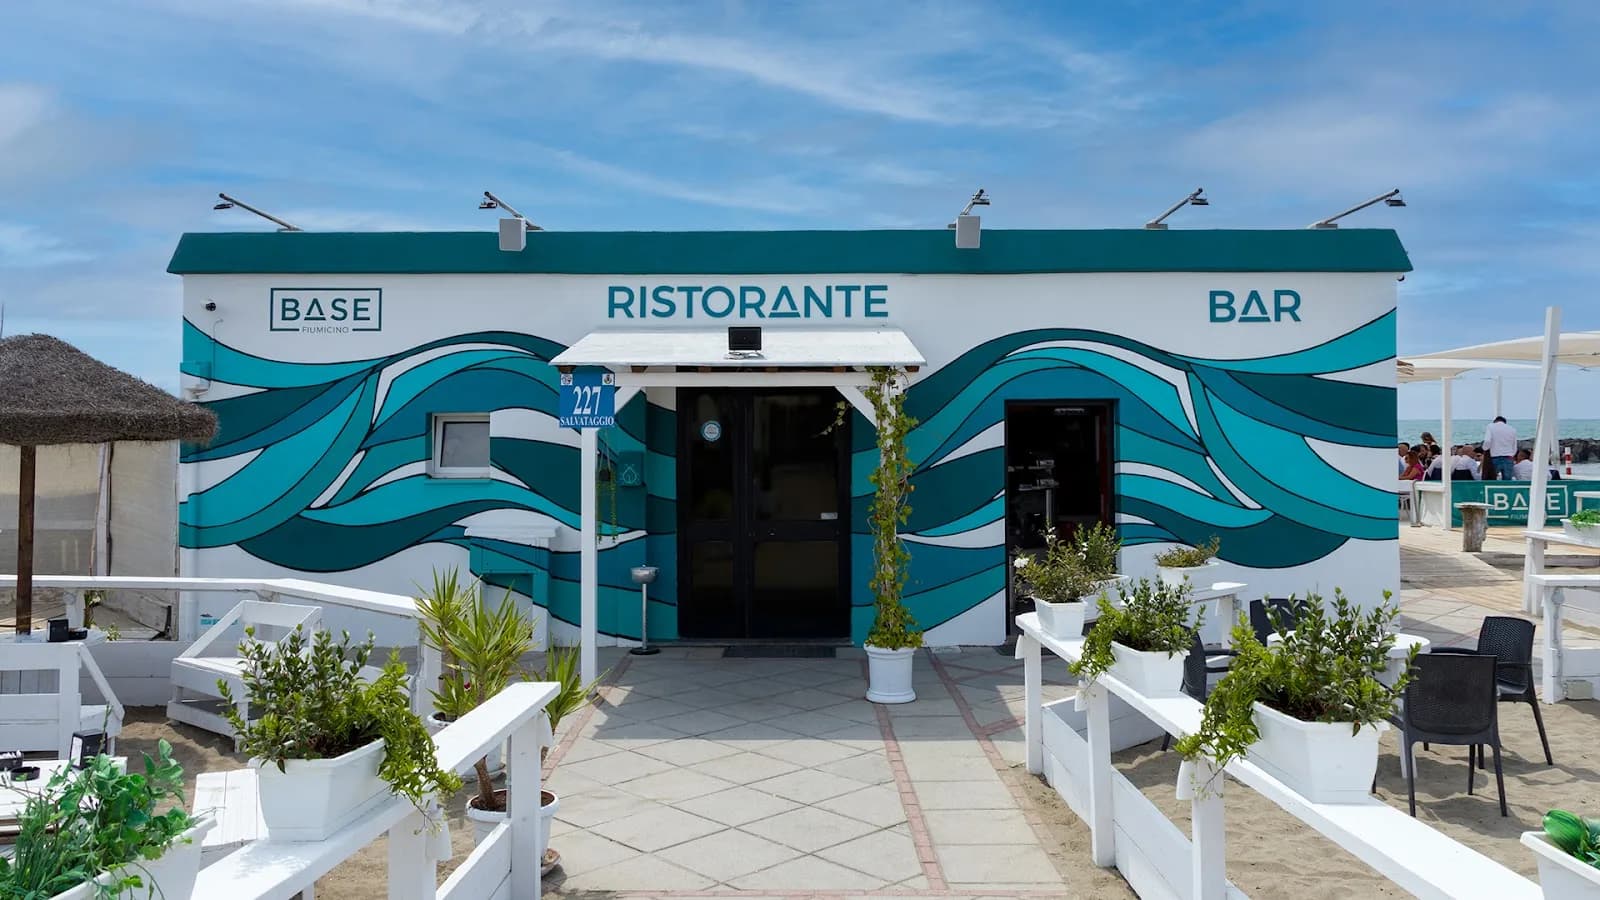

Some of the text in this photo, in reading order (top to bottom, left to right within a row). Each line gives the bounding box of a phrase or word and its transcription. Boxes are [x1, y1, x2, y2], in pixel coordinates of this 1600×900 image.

[281, 297, 371, 321] BASE
[607, 285, 889, 318] RISTORANTE
[1209, 289, 1302, 323] BAR
[302, 326, 349, 334] FIUMICINO
[572, 385, 602, 416] 227
[560, 415, 615, 426] SALVATAGGIO
[1493, 492, 1561, 511] BAE
